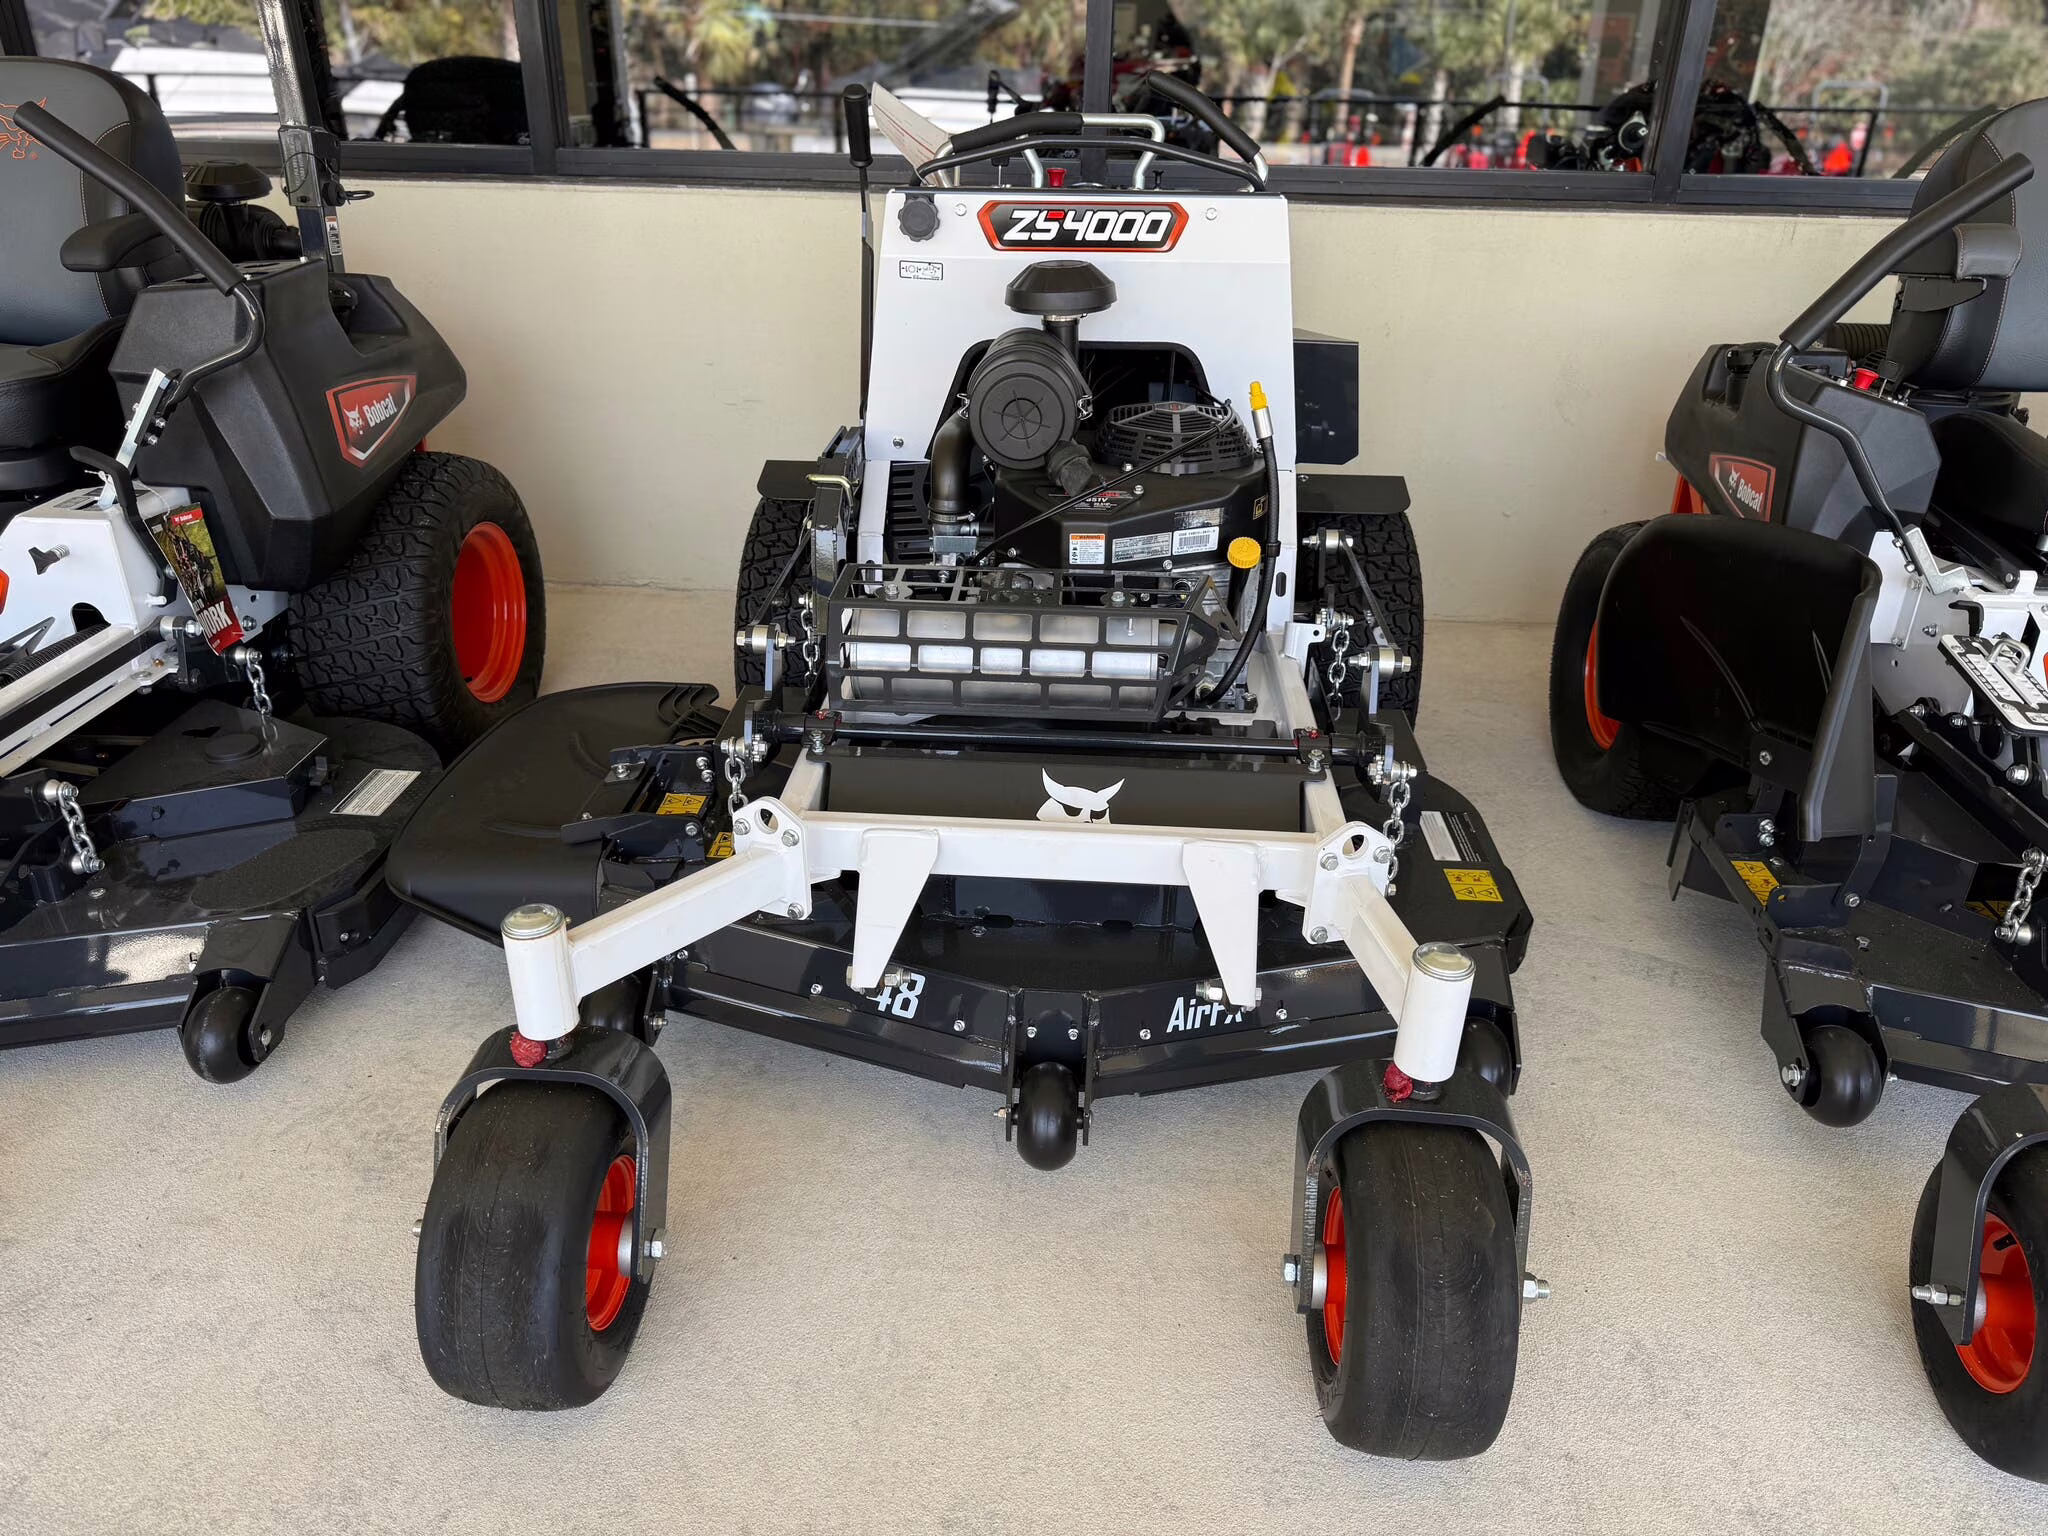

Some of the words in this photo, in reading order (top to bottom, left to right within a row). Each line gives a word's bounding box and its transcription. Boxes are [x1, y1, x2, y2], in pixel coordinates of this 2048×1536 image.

[1003, 210, 1172, 242] ZS4000
[362, 392, 398, 428] Bobcat
[1736, 478, 1763, 513] Bobcat
[197, 600, 233, 639] WORK
[866, 972, 926, 1019] 48
